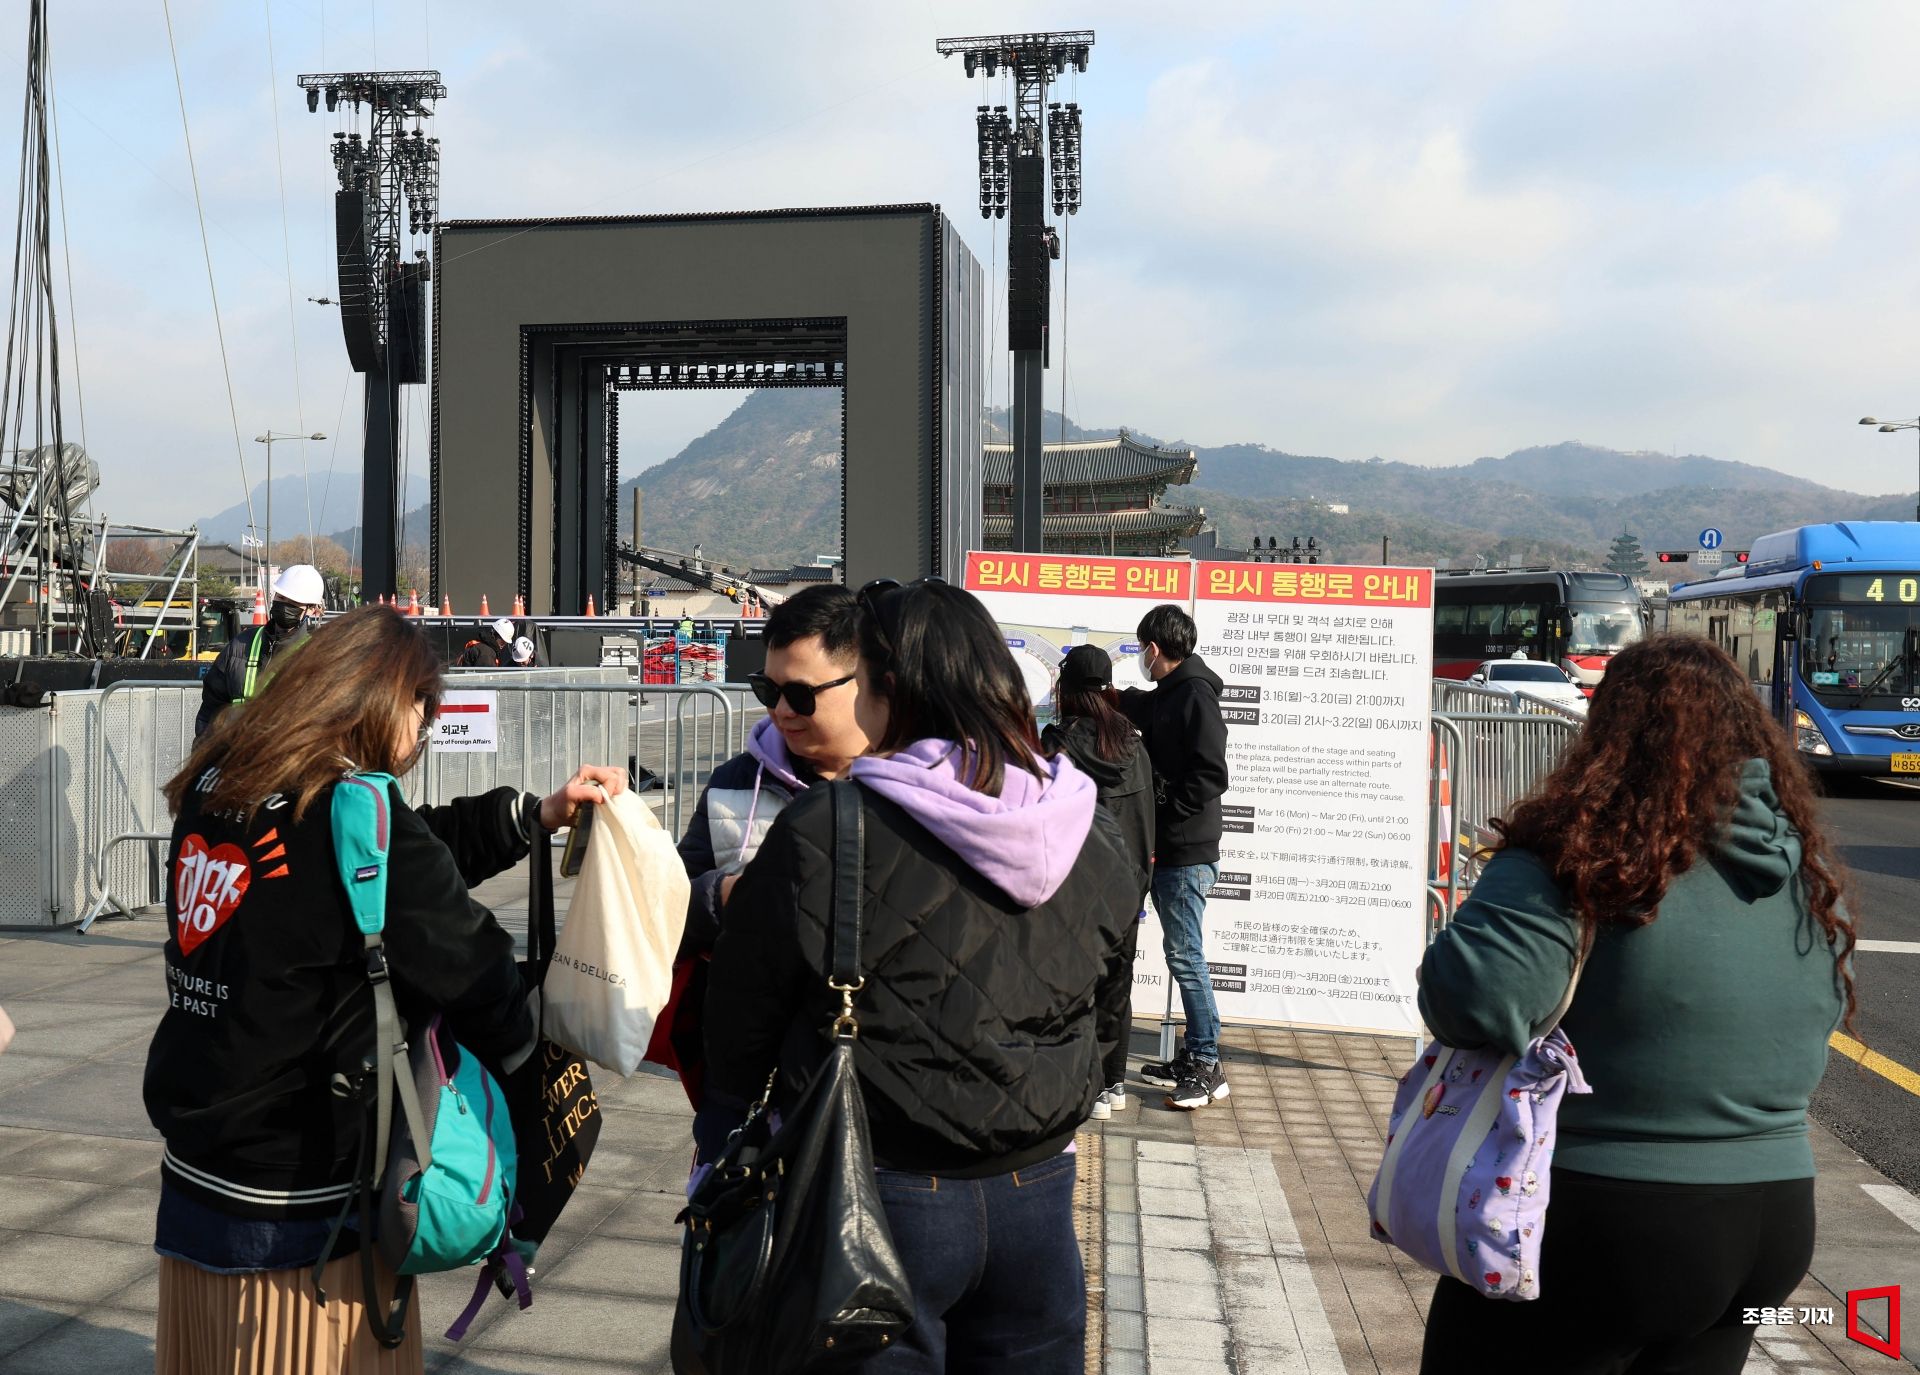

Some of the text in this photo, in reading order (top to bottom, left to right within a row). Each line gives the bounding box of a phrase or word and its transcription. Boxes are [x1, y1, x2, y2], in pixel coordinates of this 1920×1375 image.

[979, 560, 1179, 592] 임시 통행로 안내
[1211, 569, 1418, 600] 임시 통행로 안내
[1228, 613, 1392, 629] 광장 내 무대 및 객석 설치로 인해
[1223, 629, 1395, 646] 광장 내부 통행이 일부 제한됩니다.
[1199, 645, 1417, 664] 보행자의 안전을 위해 우회하시기 바랍니다.
[1230, 664, 1388, 680] 이용에 불편을 드려 죄송합니다.
[1356, 695, 1404, 706] 21:00까지
[442, 724, 469, 735] 외교부
[1262, 713, 1301, 725] 3.20(금)
[1376, 719, 1421, 731] 06시까지
[1259, 744, 1300, 752] installation
[1326, 748, 1348, 756] stage
[1367, 750, 1395, 759] seating
[1274, 755, 1315, 766] pedestrian
[1251, 764, 1271, 772] plaza
[1299, 768, 1330, 777] partially
[1332, 769, 1371, 777] restricted.
[1250, 775, 1274, 784] safety,
[1277, 776, 1302, 785] please
[1332, 779, 1366, 788] alternate
[1228, 784, 1255, 793] ologize
[1270, 788, 1284, 796] any
[1286, 787, 1343, 798] inconvenience
[1345, 790, 1359, 798] this
[1287, 810, 1309, 820] (Mon)
[1320, 812, 1335, 820] Mar
[1337, 813, 1347, 821] 20
[1385, 816, 1408, 824] 21:00
[1286, 826, 1301, 836] (Fri)
[1303, 827, 1325, 835] 21:00
[1336, 829, 1351, 837] Mar
[1353, 830, 1363, 838] 22
[1365, 831, 1386, 840] (Sun)
[1388, 832, 1410, 841] 06:00
[574, 960, 579, 969] &
[581, 963, 626, 988] DELUCA
[1208, 964, 1242, 974] 行可能期間
[216, 983, 229, 1000] IS
[183, 996, 219, 1018] PAST
